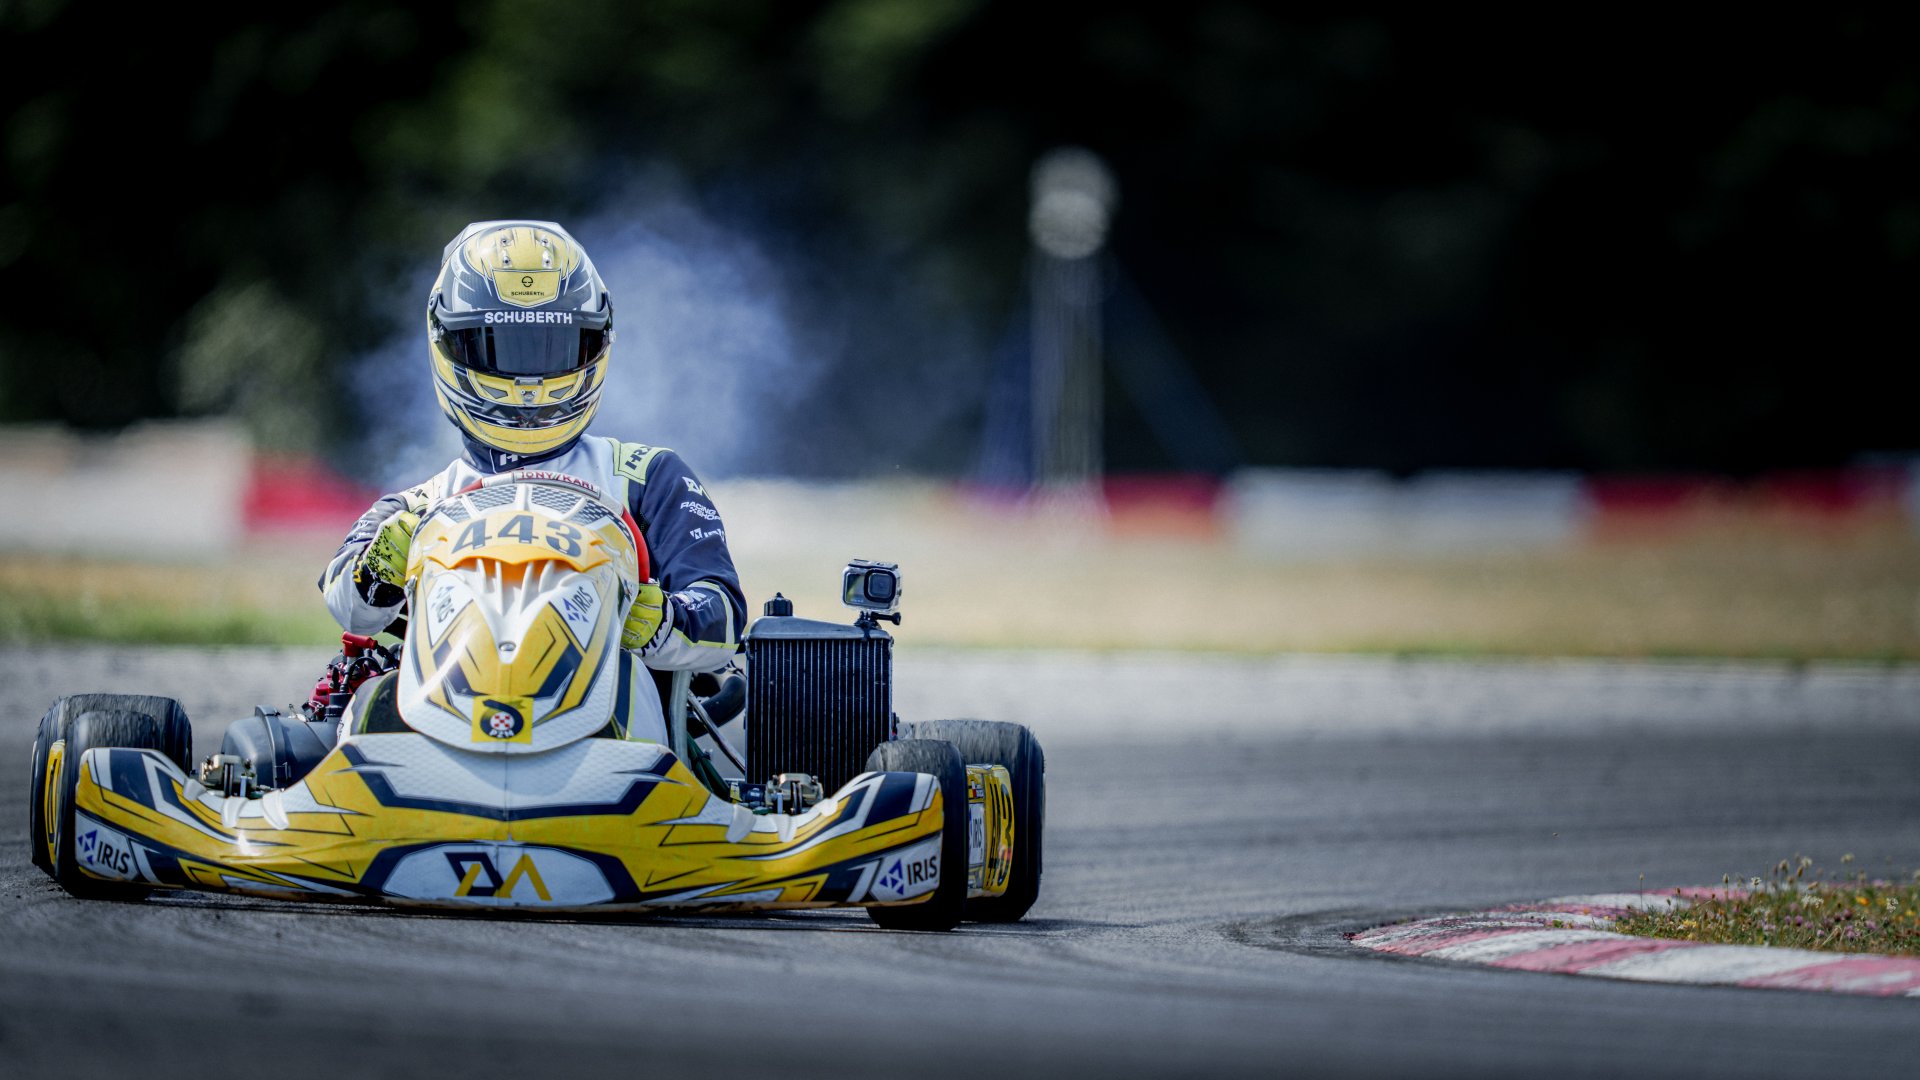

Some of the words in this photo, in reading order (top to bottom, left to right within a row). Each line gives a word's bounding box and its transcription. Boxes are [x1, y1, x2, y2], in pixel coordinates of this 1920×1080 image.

[484, 311, 573, 325] SCHUBERTH
[680, 501, 717, 516] RACING
[451, 514, 583, 558] 443
[574, 586, 594, 615] IRIS
[973, 818, 982, 849] IRIS
[97, 841, 130, 875] IRIS
[907, 856, 938, 886] IRIS
